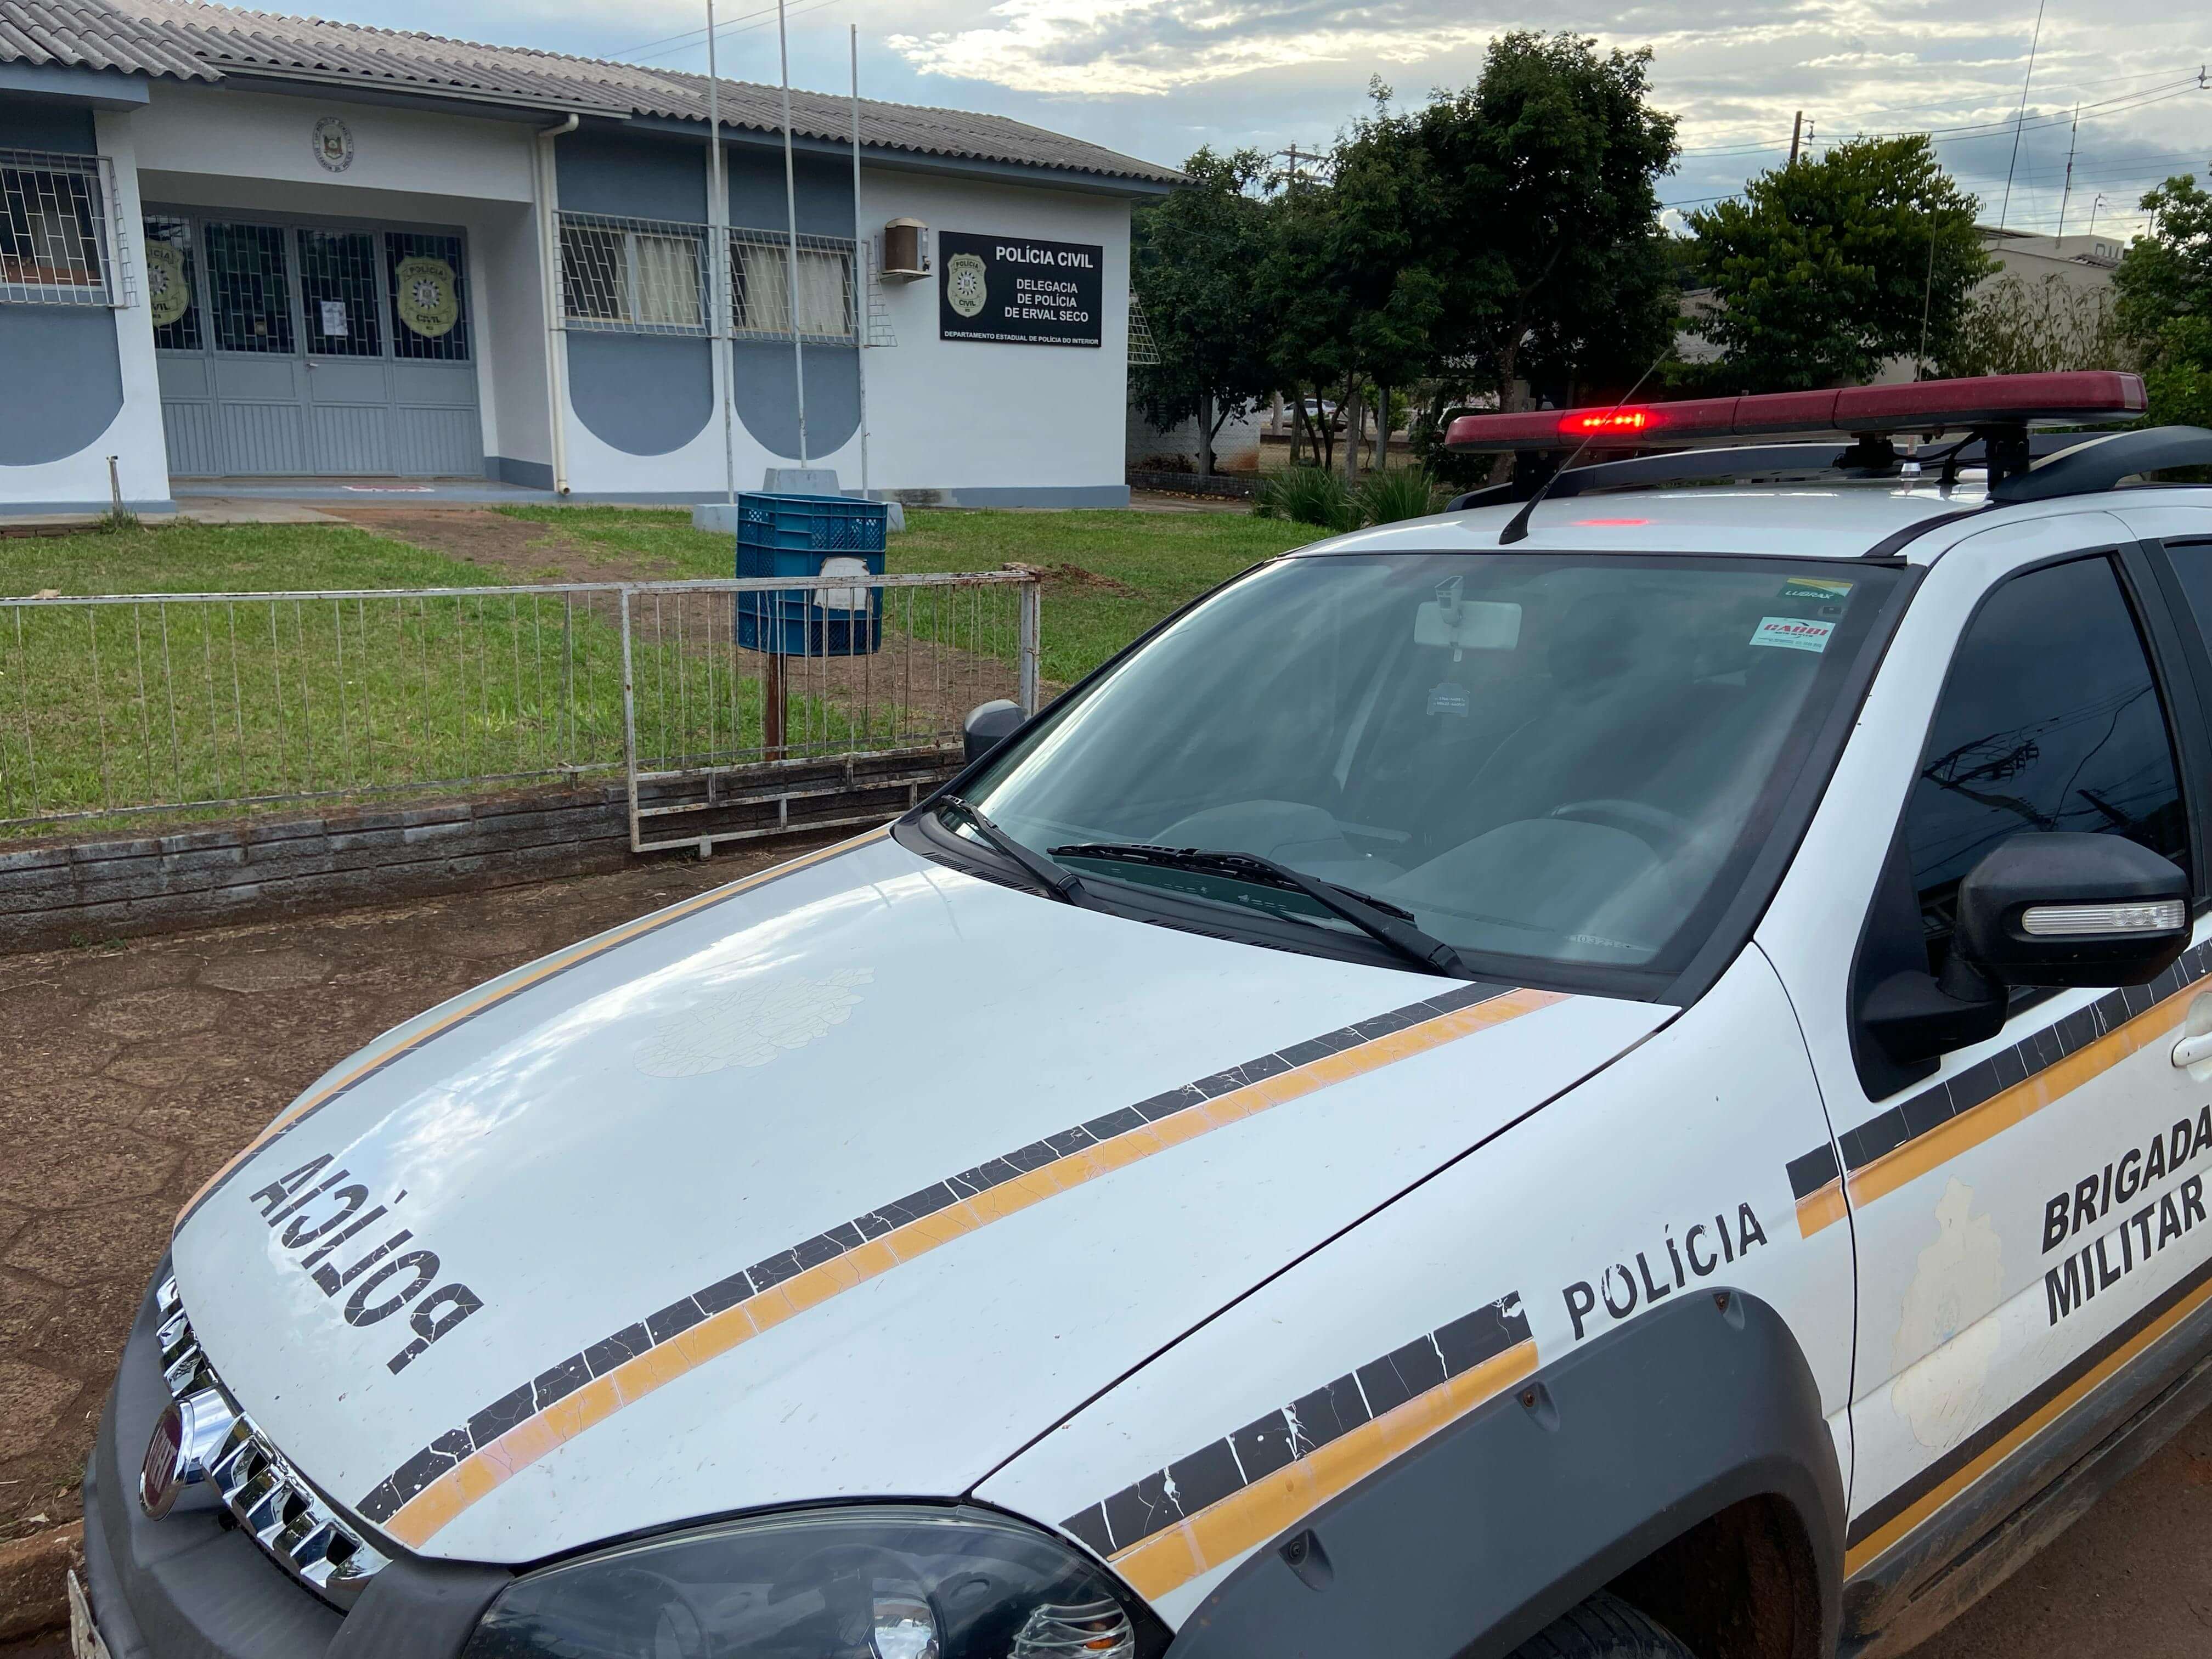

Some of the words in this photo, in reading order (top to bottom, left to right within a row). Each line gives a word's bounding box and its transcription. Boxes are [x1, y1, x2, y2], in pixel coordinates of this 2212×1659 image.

[996, 245, 1054, 266] POLÍCIA
[1058, 252, 1093, 268] CIVIL
[1016, 278, 1078, 294] DELEGACIA
[1017, 293, 1032, 304] DE
[1035, 294, 1077, 308] POLÍCIA
[1005, 307, 1019, 318] DE
[1022, 308, 1057, 321] ERVAL
[1059, 311, 1088, 323] SECO
[944, 331, 995, 340] DEPARTAMENTO
[1785, 590, 1834, 599] LUBRAX
[2042, 1105, 2212, 1255] BRIGADA
[2044, 1173, 2207, 1327] MILITAR
[1562, 1201, 1768, 1341] POLÍCIA
